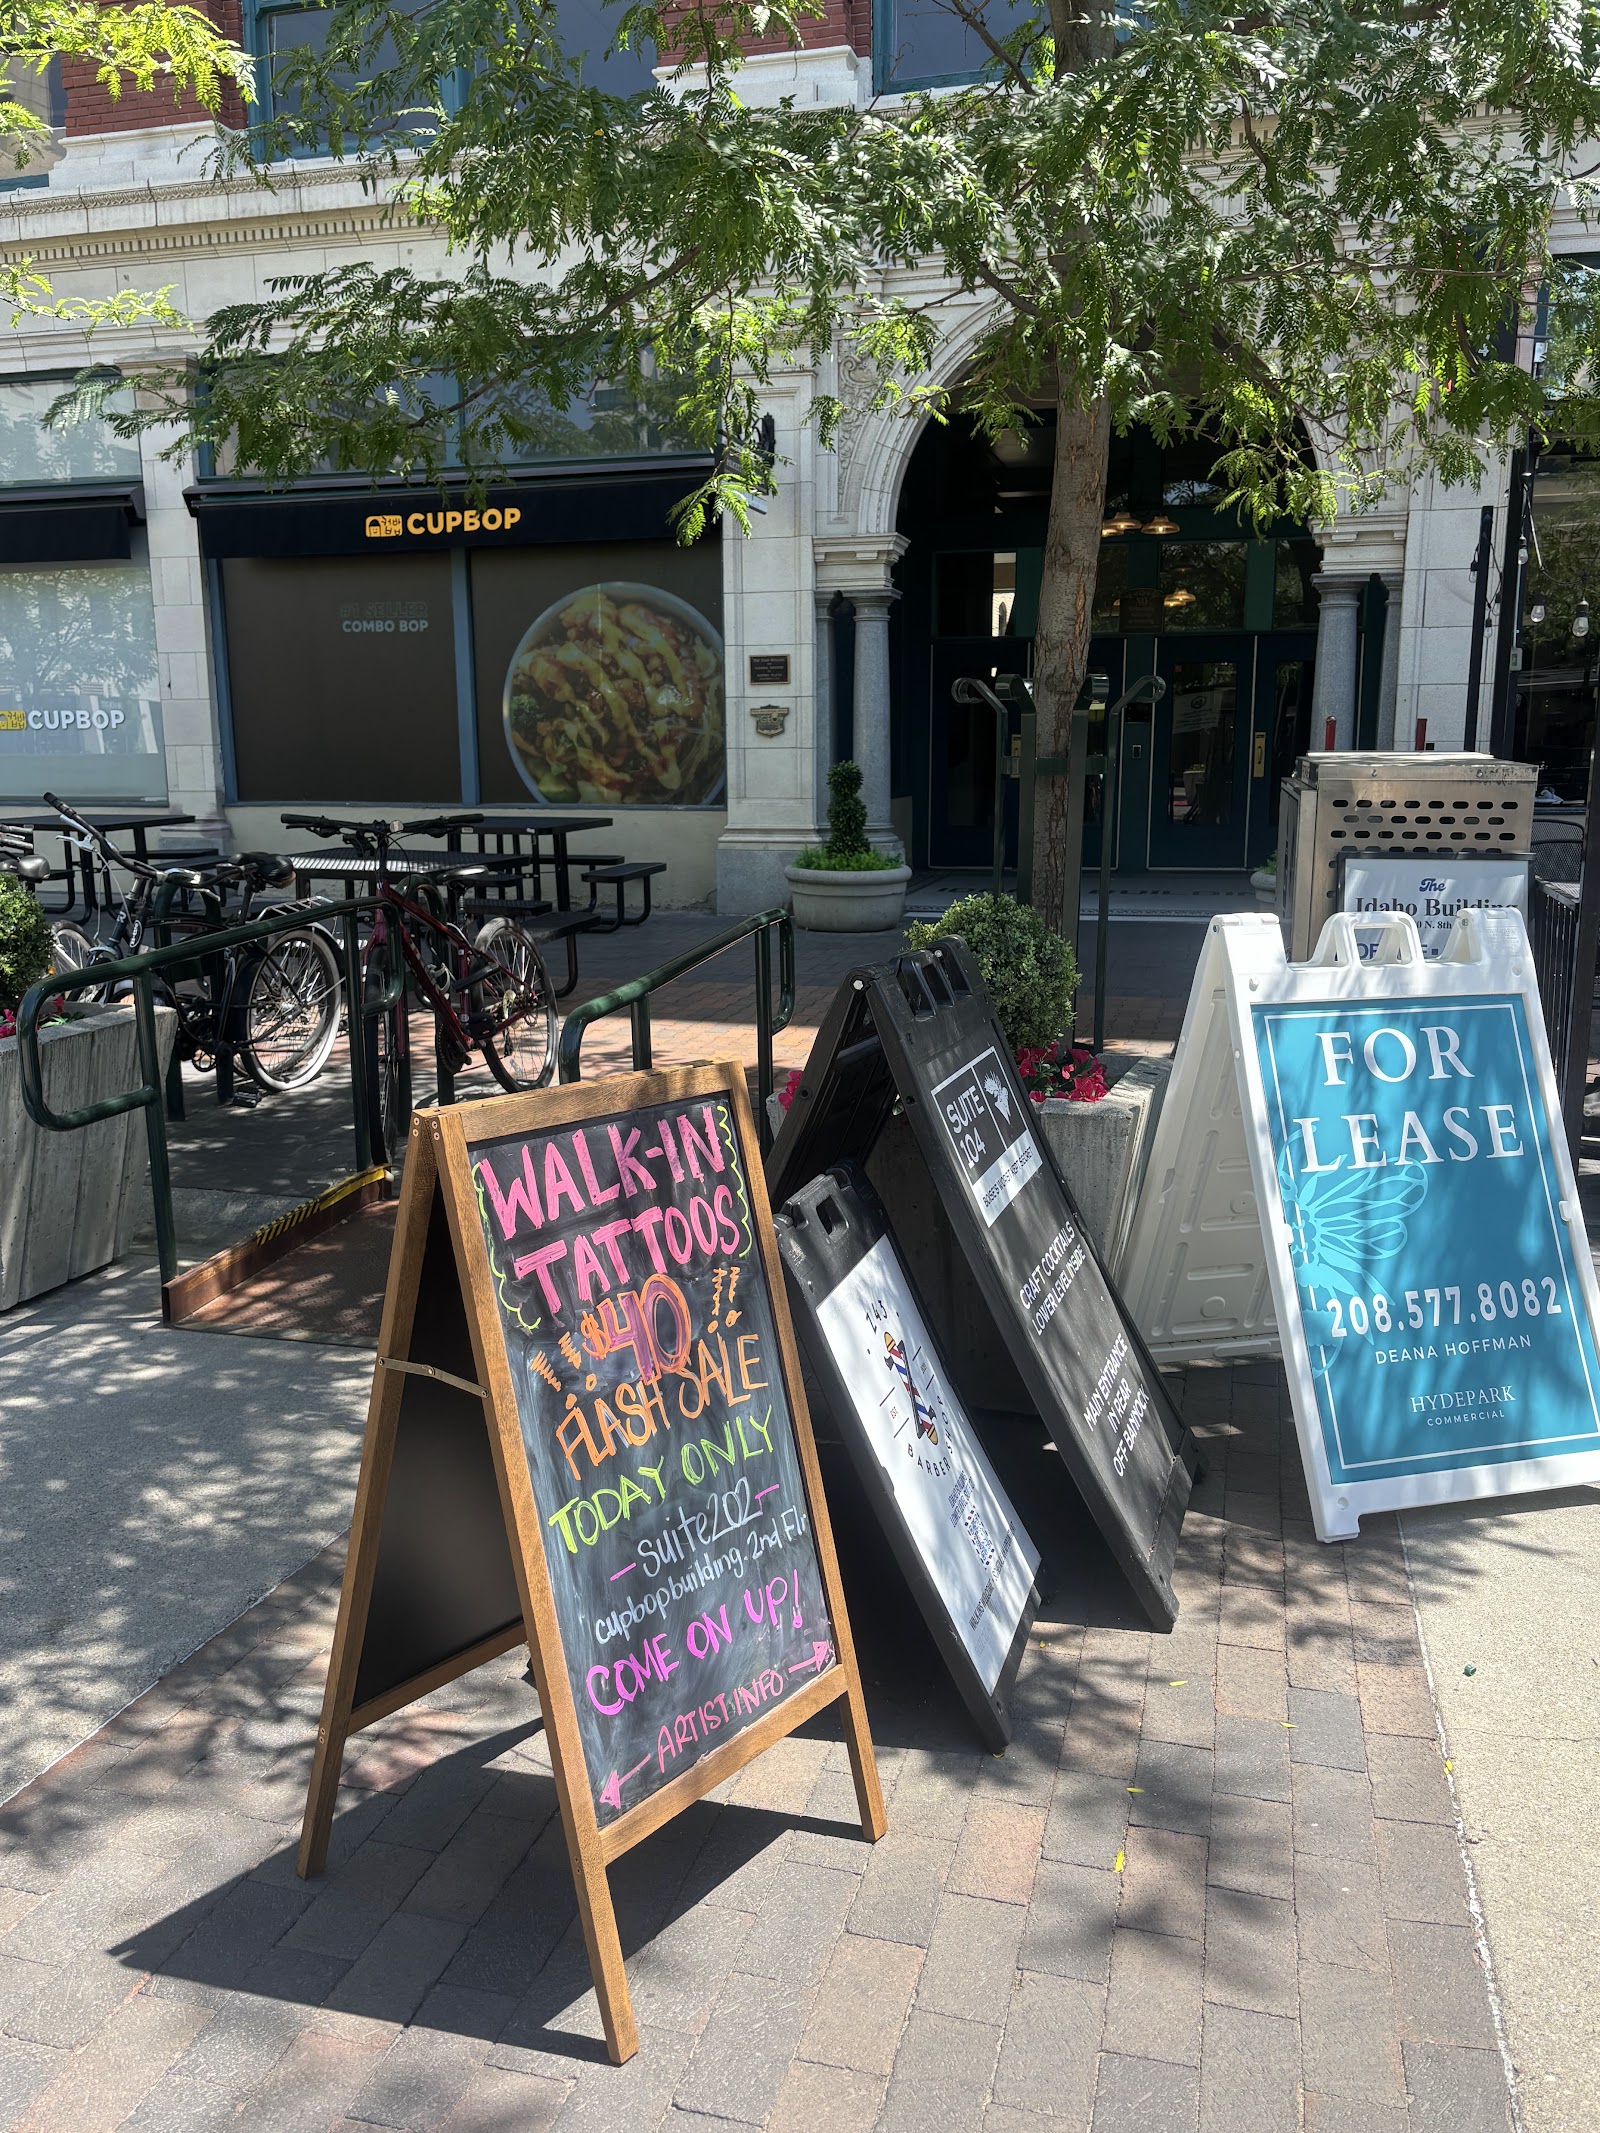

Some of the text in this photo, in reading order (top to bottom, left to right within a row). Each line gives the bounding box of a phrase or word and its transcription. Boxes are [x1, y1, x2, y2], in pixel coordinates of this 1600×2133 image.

[407, 507, 521, 535] CUPBOP
[342, 620, 428, 632] COMBO BOP
[28, 710, 125, 730] CUPBOP
[1355, 898, 1418, 917] Idaho
[1418, 878, 1446, 892] The
[1315, 1026, 1475, 1086] FOR
[946, 1085, 985, 1134] SUITE
[1293, 1104, 1524, 1173] LEASE
[478, 1107, 725, 1241] WALK-IN
[959, 1127, 987, 1169] 104
[514, 1184, 740, 1317] TATTOOS
[1019, 1220, 1076, 1310] CRAFT COCKTAILS
[1031, 1243, 1086, 1336] LOWER LEVEL INSIDE
[1326, 1276, 1562, 1338] 208.577.8082
[580, 1273, 692, 1386] $40
[1375, 1334, 1532, 1365] DEANA HOFFMAN
[555, 1332, 769, 1481] FLASH SALE
[1083, 1332, 1128, 1432] MAIN ENTRANCE
[1106, 1377, 1132, 1434] IN REAR
[1410, 1385, 1516, 1413] HYDEPARK
[907, 1395, 953, 1477] BARBER SHOP
[1113, 1383, 1150, 1477] OFF BANNOCK
[1426, 1409, 1505, 1427] COMMERCIAL
[548, 1404, 773, 1554] TODAY ONLY
[746, 1517, 783, 1560] 2nd
[586, 1568, 803, 1715] COME ON UP!
[656, 1668, 784, 1773] ARTIST INFO
